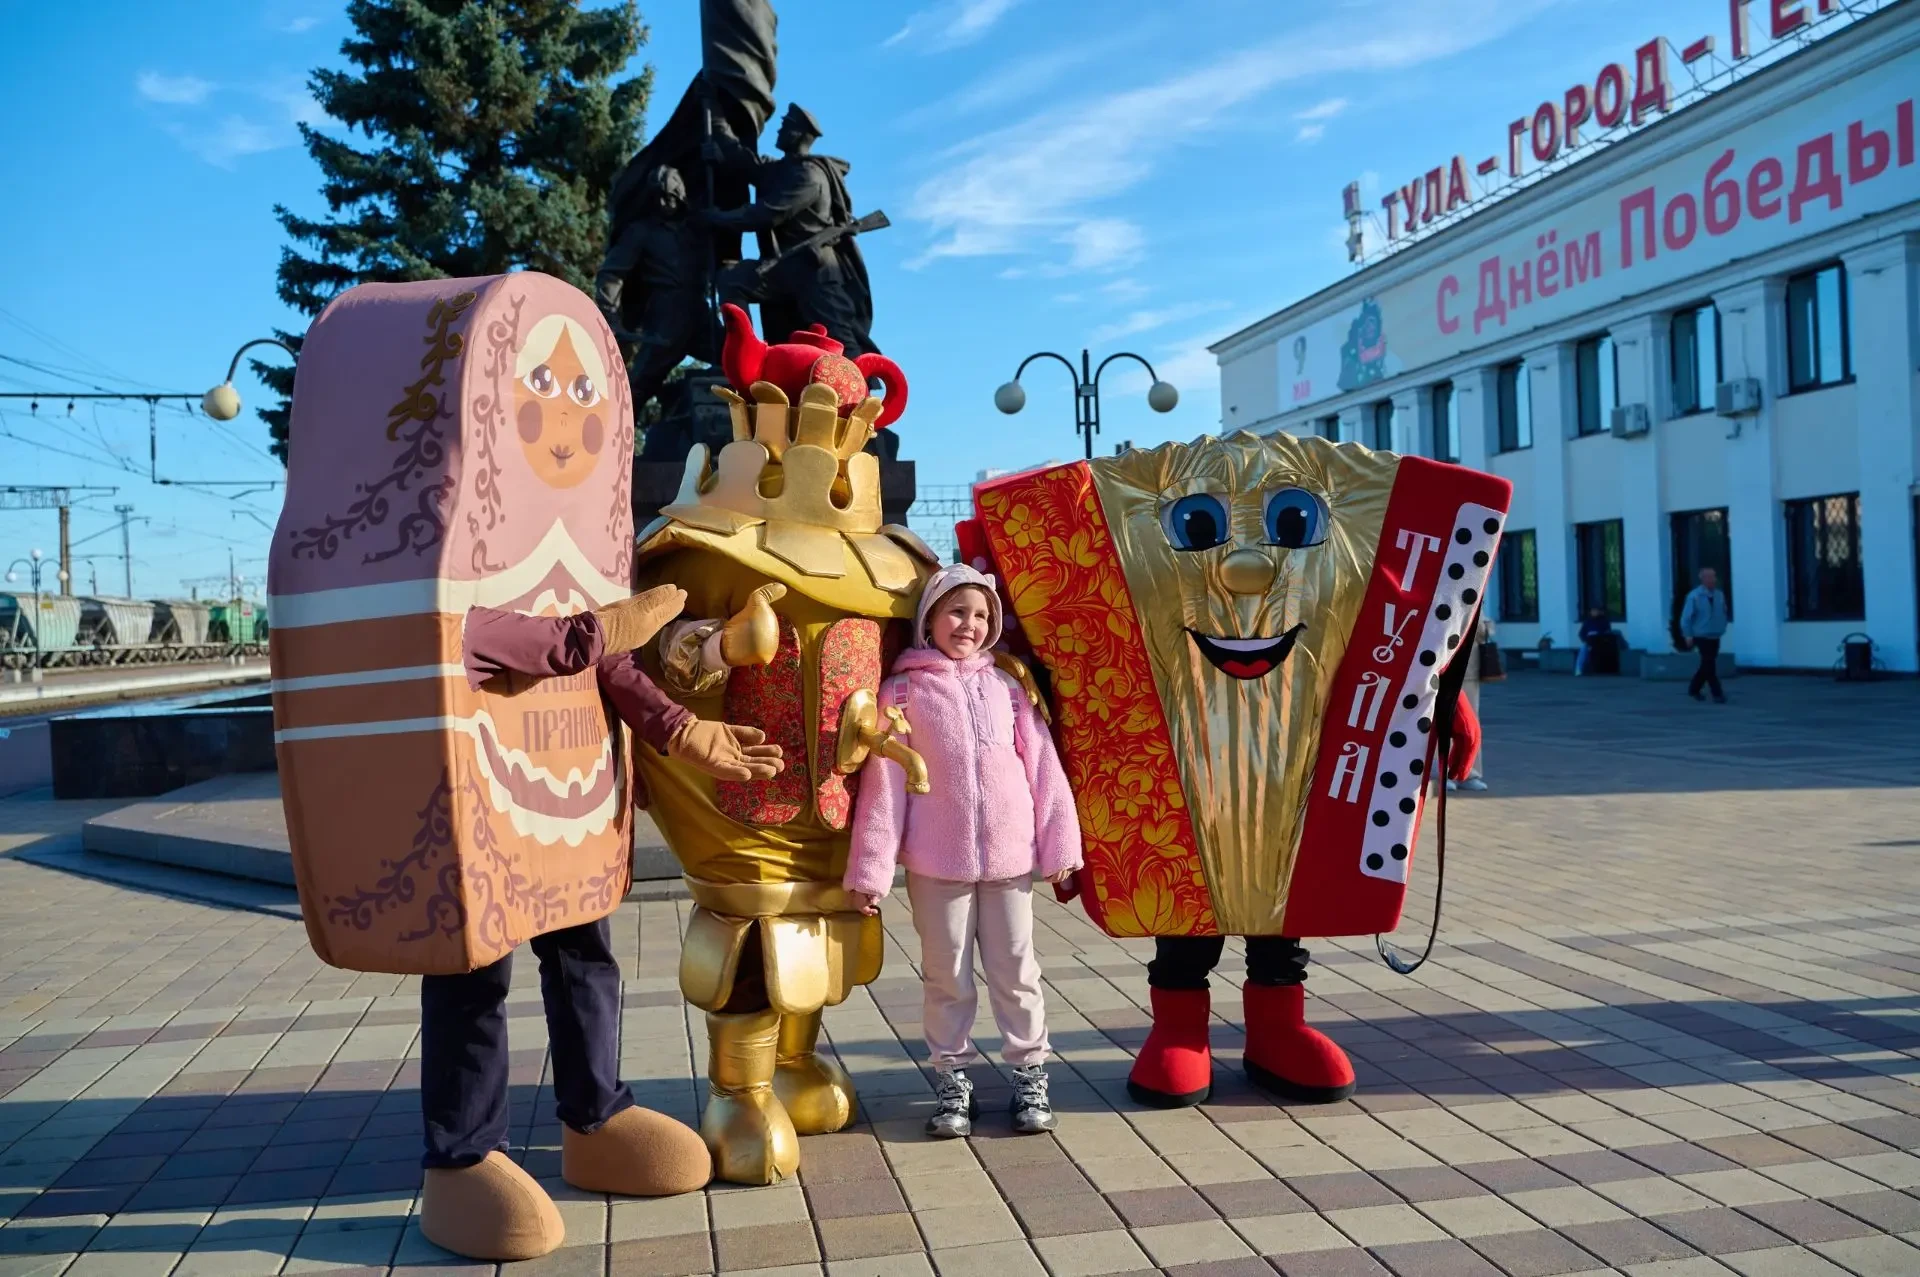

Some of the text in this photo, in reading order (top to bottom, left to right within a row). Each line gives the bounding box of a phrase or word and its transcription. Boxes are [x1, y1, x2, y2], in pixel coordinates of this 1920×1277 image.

[1381, 155, 1472, 240] ТУЛА
[1508, 36, 1674, 178] ГОРОД
[1436, 99, 1915, 335] С Днём Победы
[522, 704, 602, 753] ПРЯНИК
[1327, 528, 1442, 804] ТУЛА
